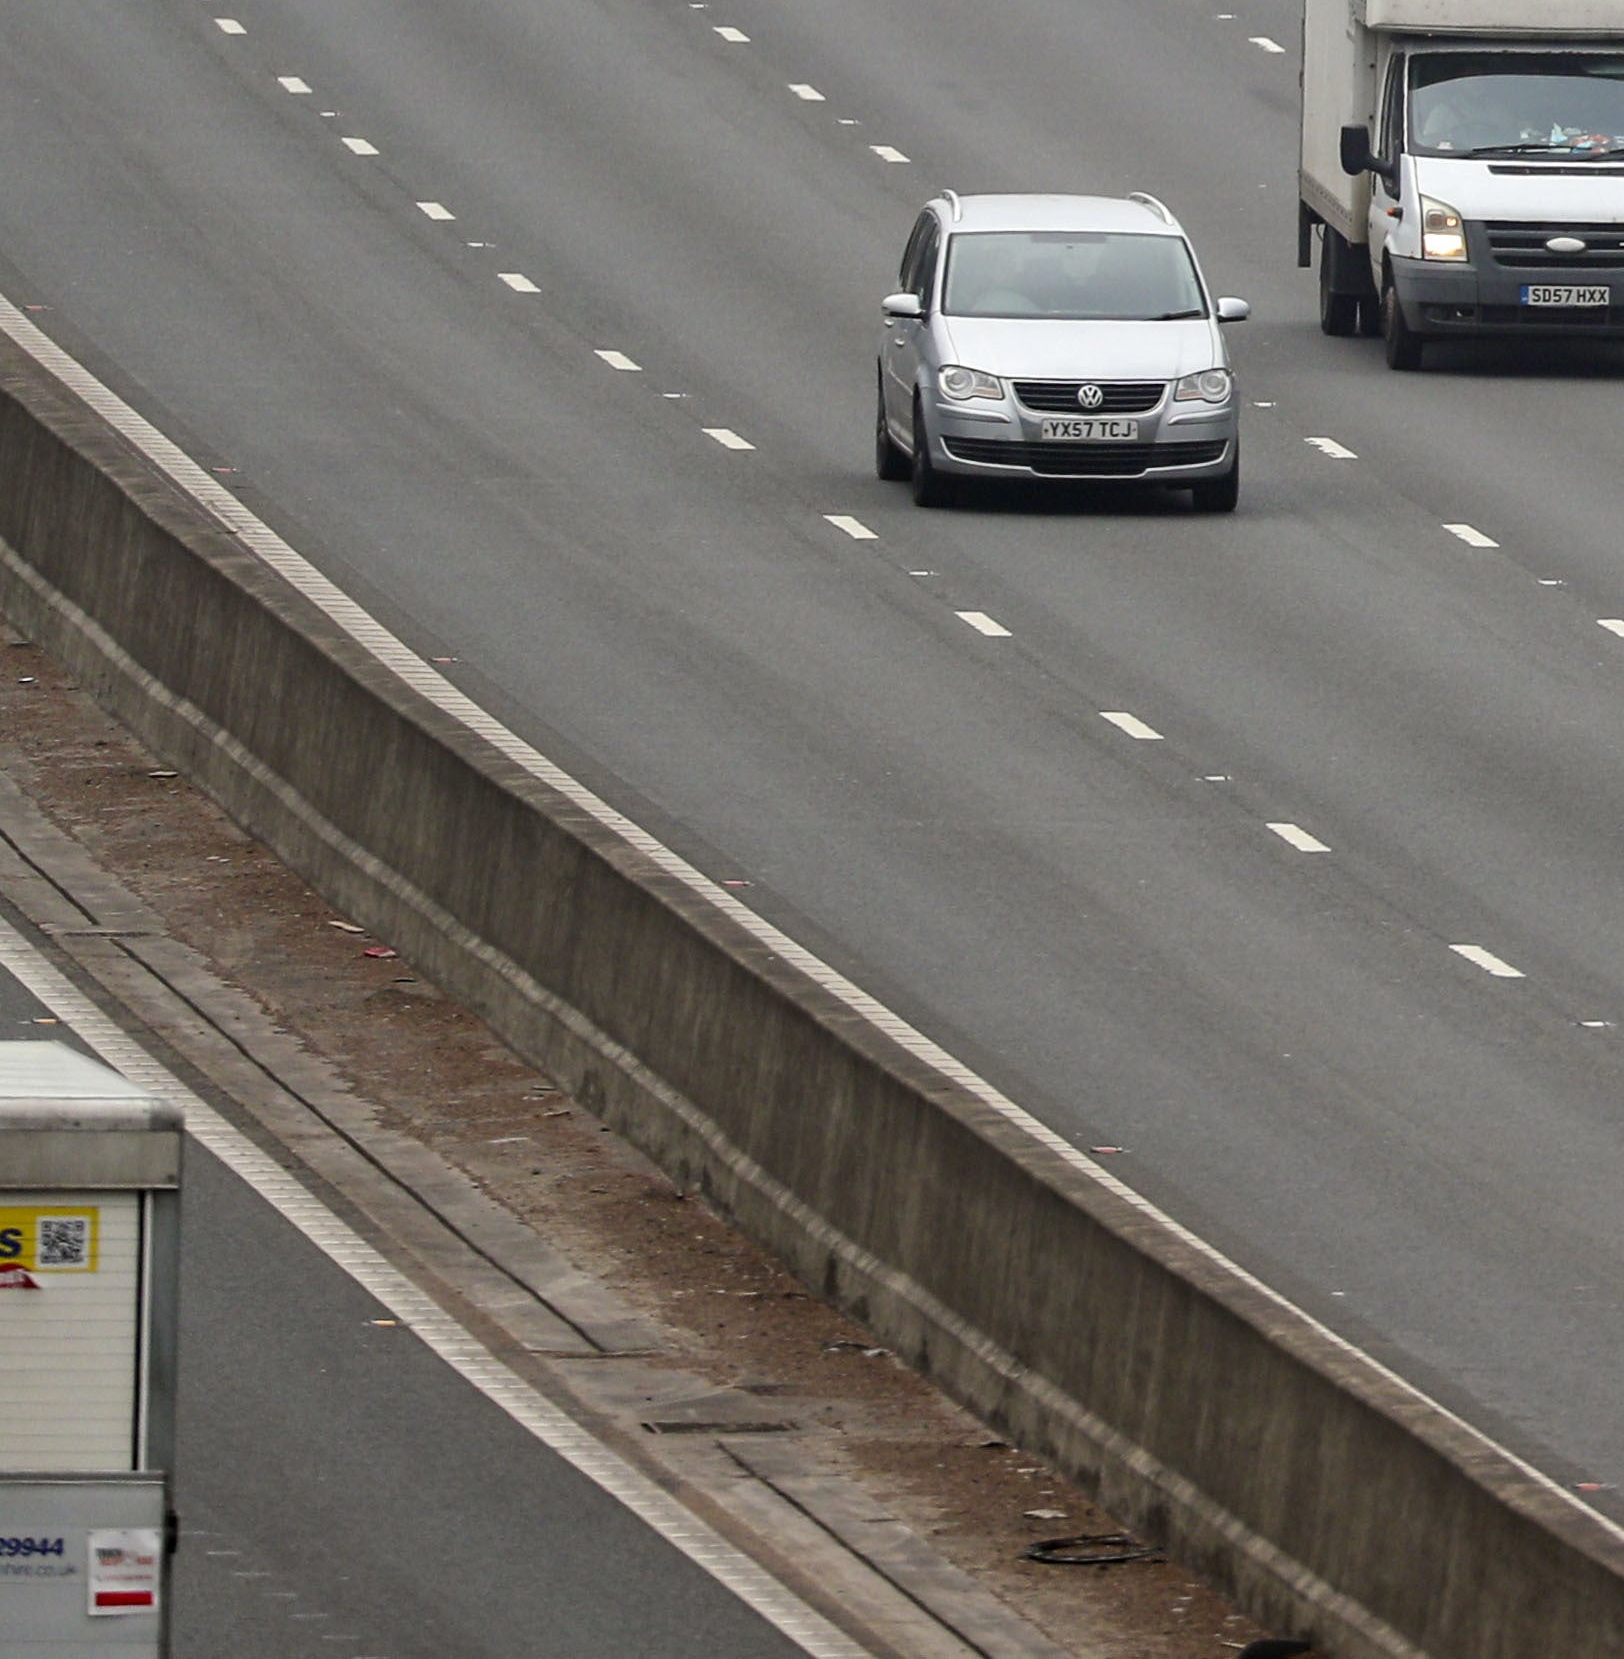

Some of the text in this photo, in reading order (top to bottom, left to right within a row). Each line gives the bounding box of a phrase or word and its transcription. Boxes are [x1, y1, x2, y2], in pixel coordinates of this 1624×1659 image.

[1531, 287, 1607, 303] SD57 HXX
[1050, 422, 1131, 437] YX57 TCJ
